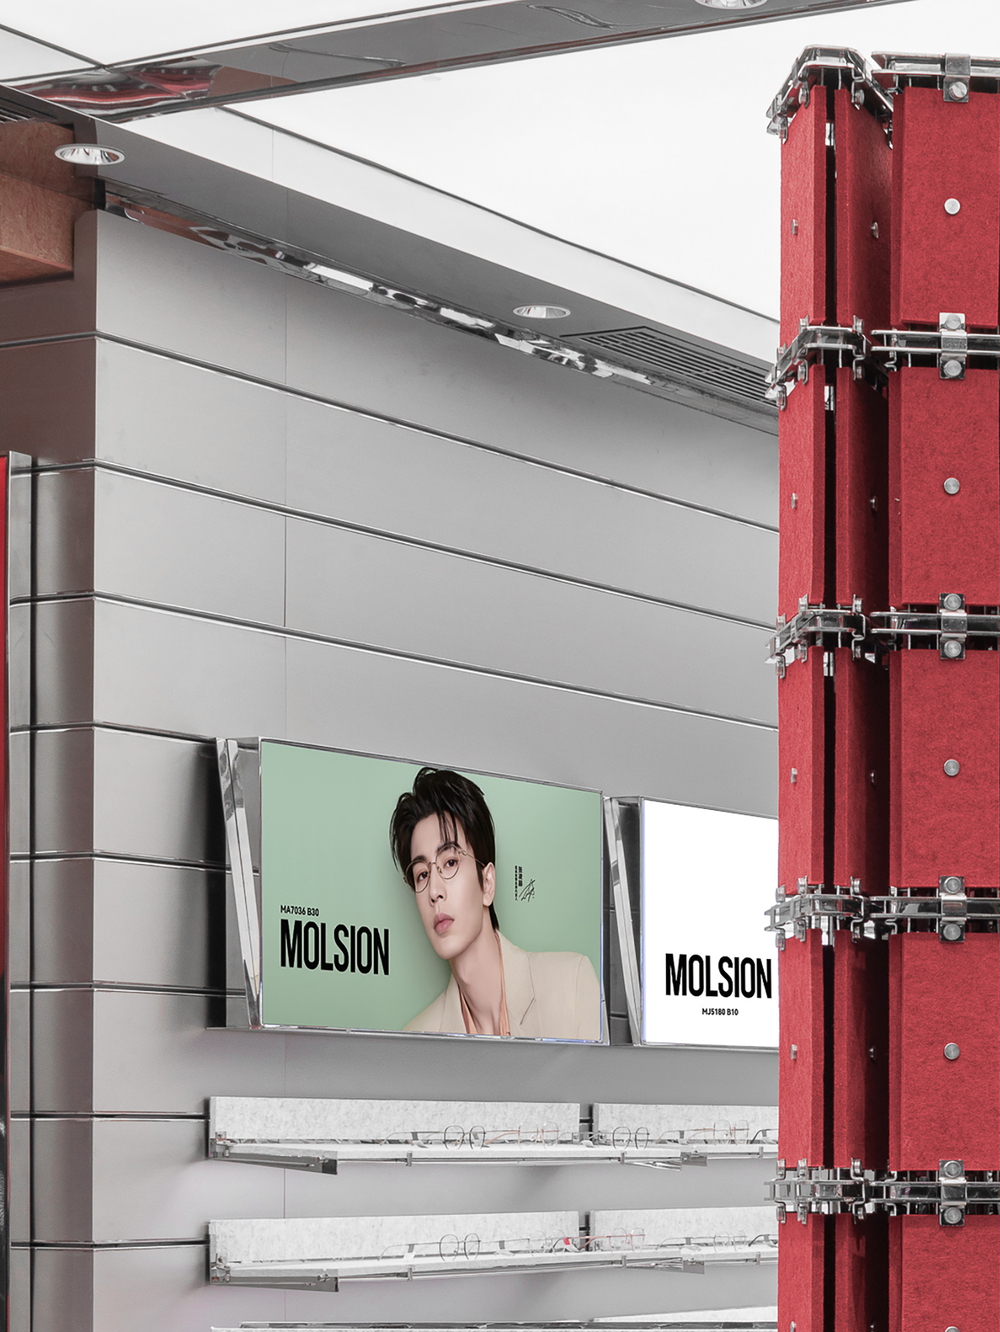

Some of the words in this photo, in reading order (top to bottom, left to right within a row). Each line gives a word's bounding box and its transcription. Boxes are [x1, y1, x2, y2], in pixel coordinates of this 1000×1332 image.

[280, 904, 306, 916] MA7036
[307, 907, 320, 917] B30
[280, 918, 390, 976] MOLSION
[665, 953, 772, 999] MOLSION
[702, 1008, 725, 1016] MJ5180
[726, 1008, 739, 1016] B10
